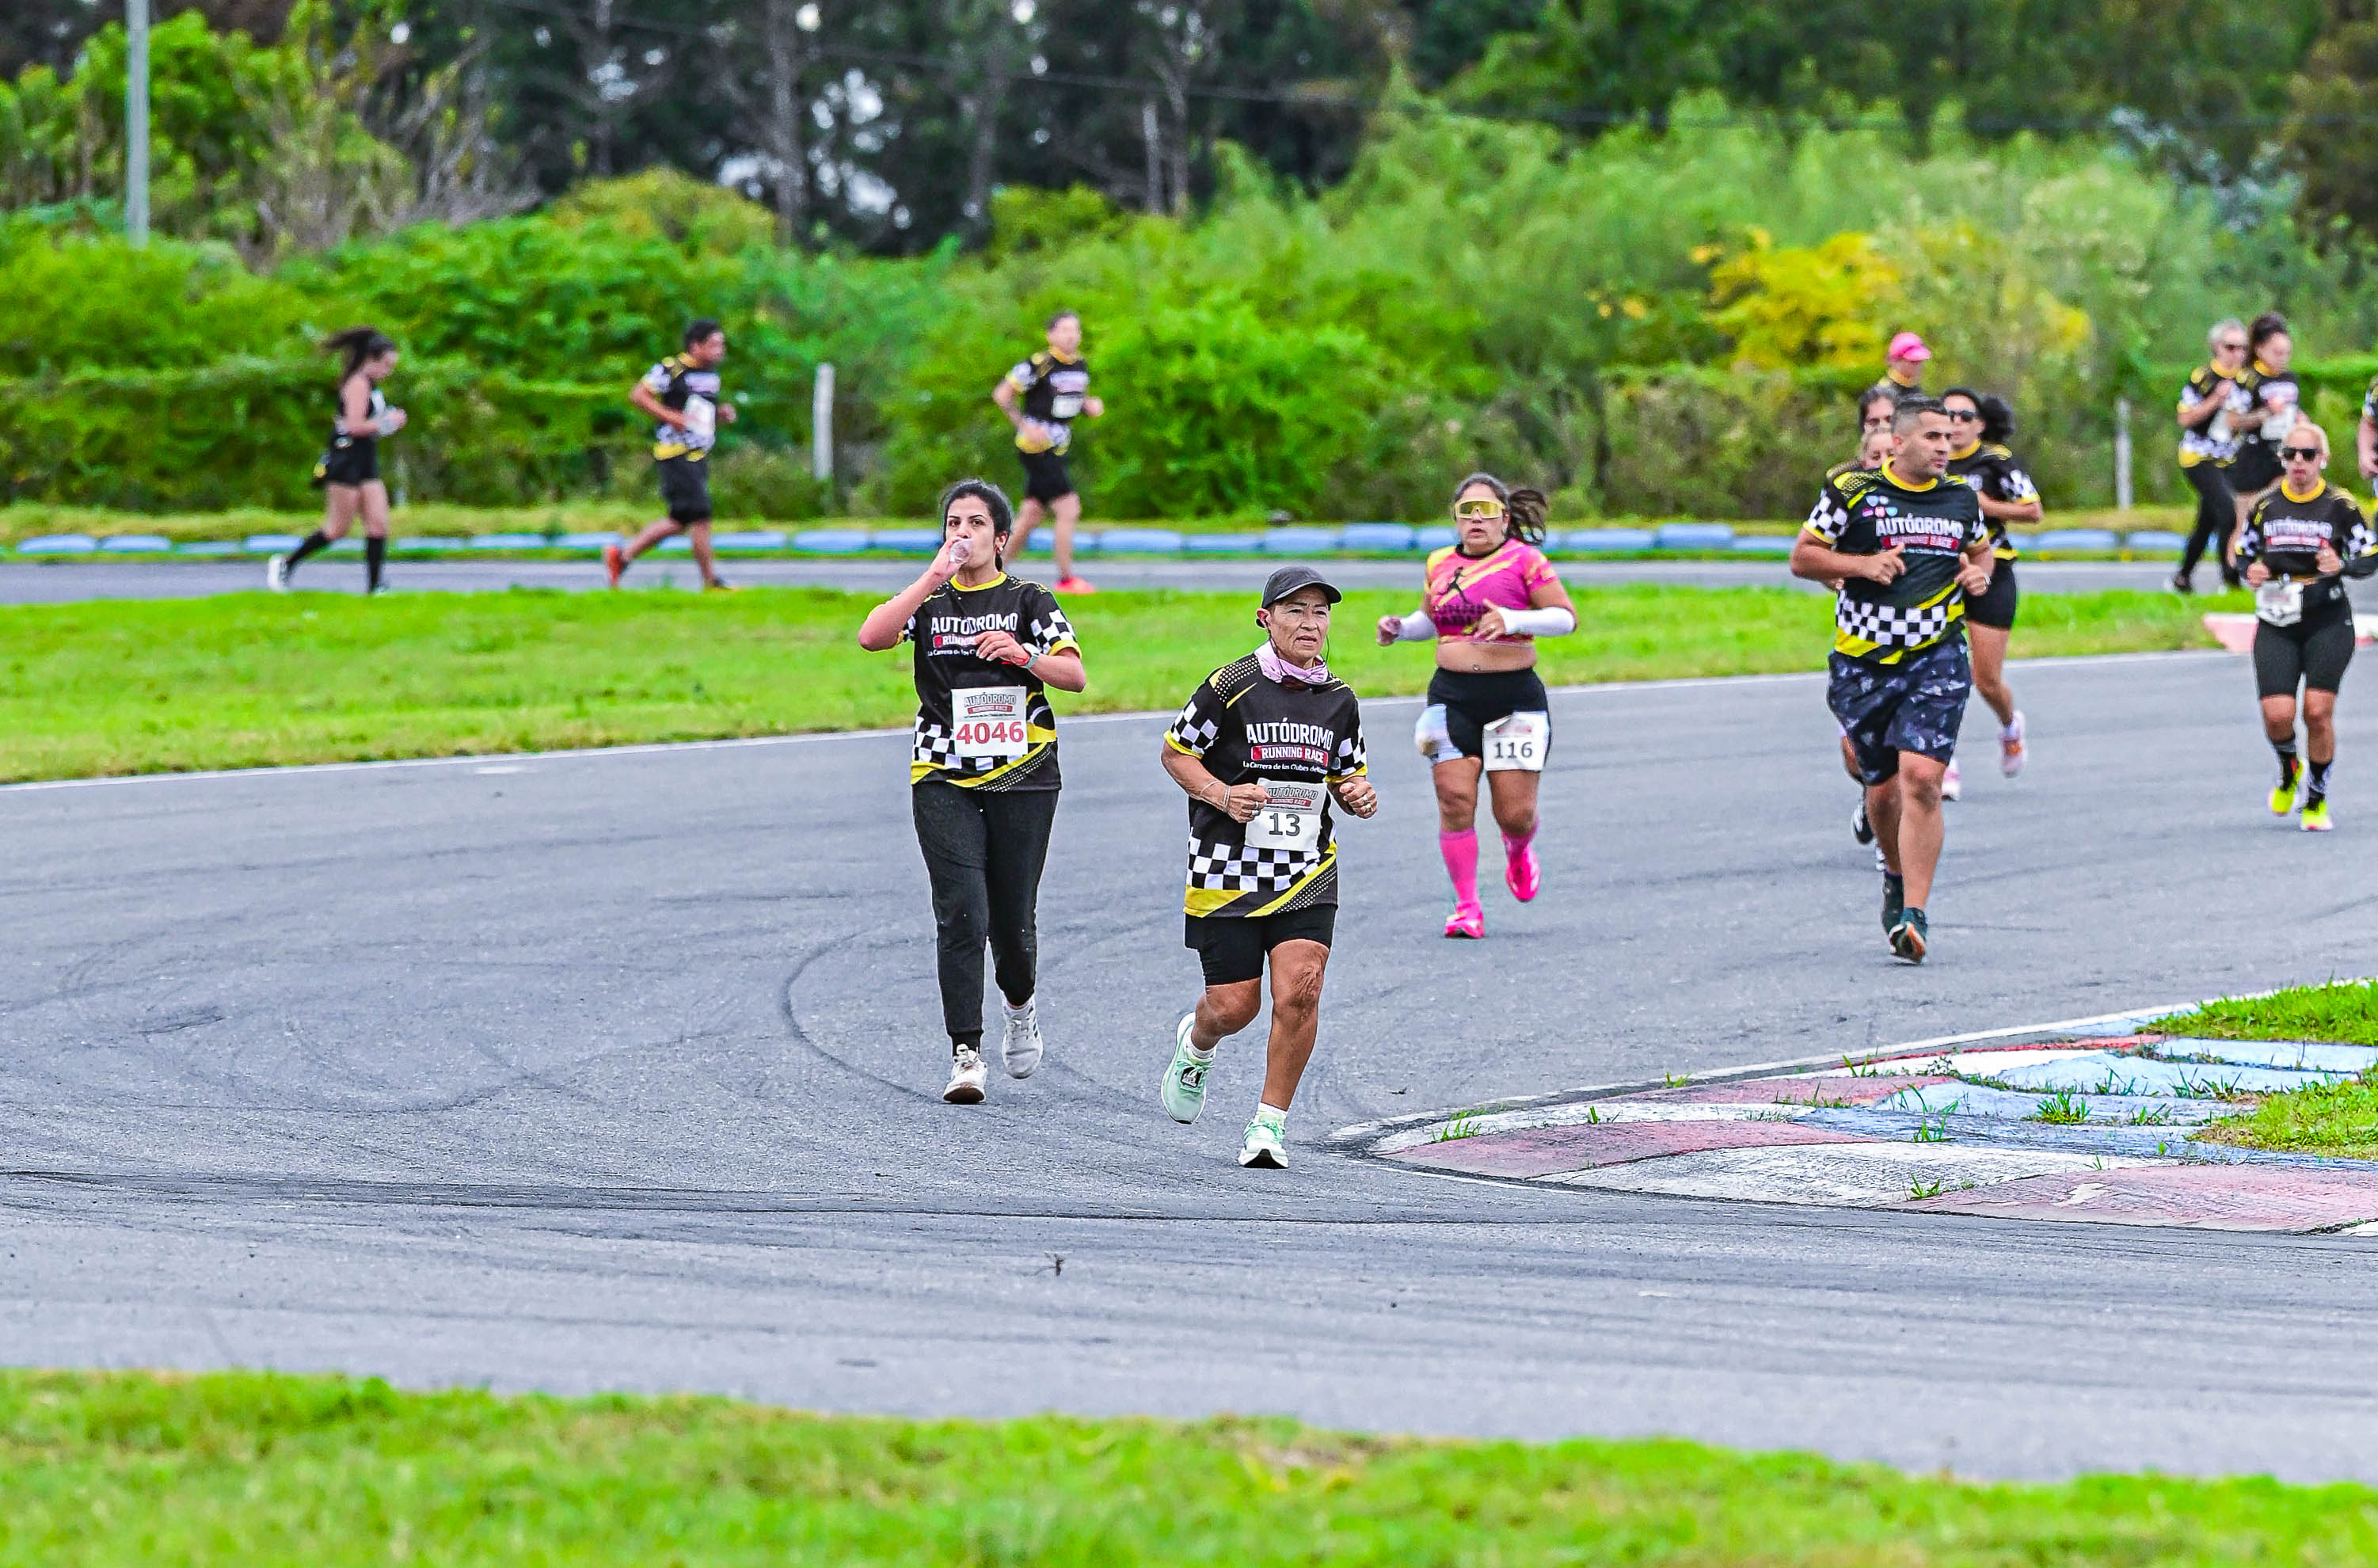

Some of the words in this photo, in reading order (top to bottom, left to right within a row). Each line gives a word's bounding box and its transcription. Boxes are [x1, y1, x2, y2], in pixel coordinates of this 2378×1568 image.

[1876, 513, 1964, 539] AUTÓDROMO
[964, 691, 1017, 707] AUTÓDROMO
[956, 721, 1024, 744] 4046
[1246, 717, 1334, 751] AUTÓDROMO
[1261, 746, 1303, 759] RUNNING
[1304, 747, 1325, 764] RACE
[1493, 741, 1533, 759] 116
[1249, 761, 1273, 770] Carrera
[1267, 784, 1318, 801] AUTÓDROMO
[1269, 813, 1300, 837] 13
